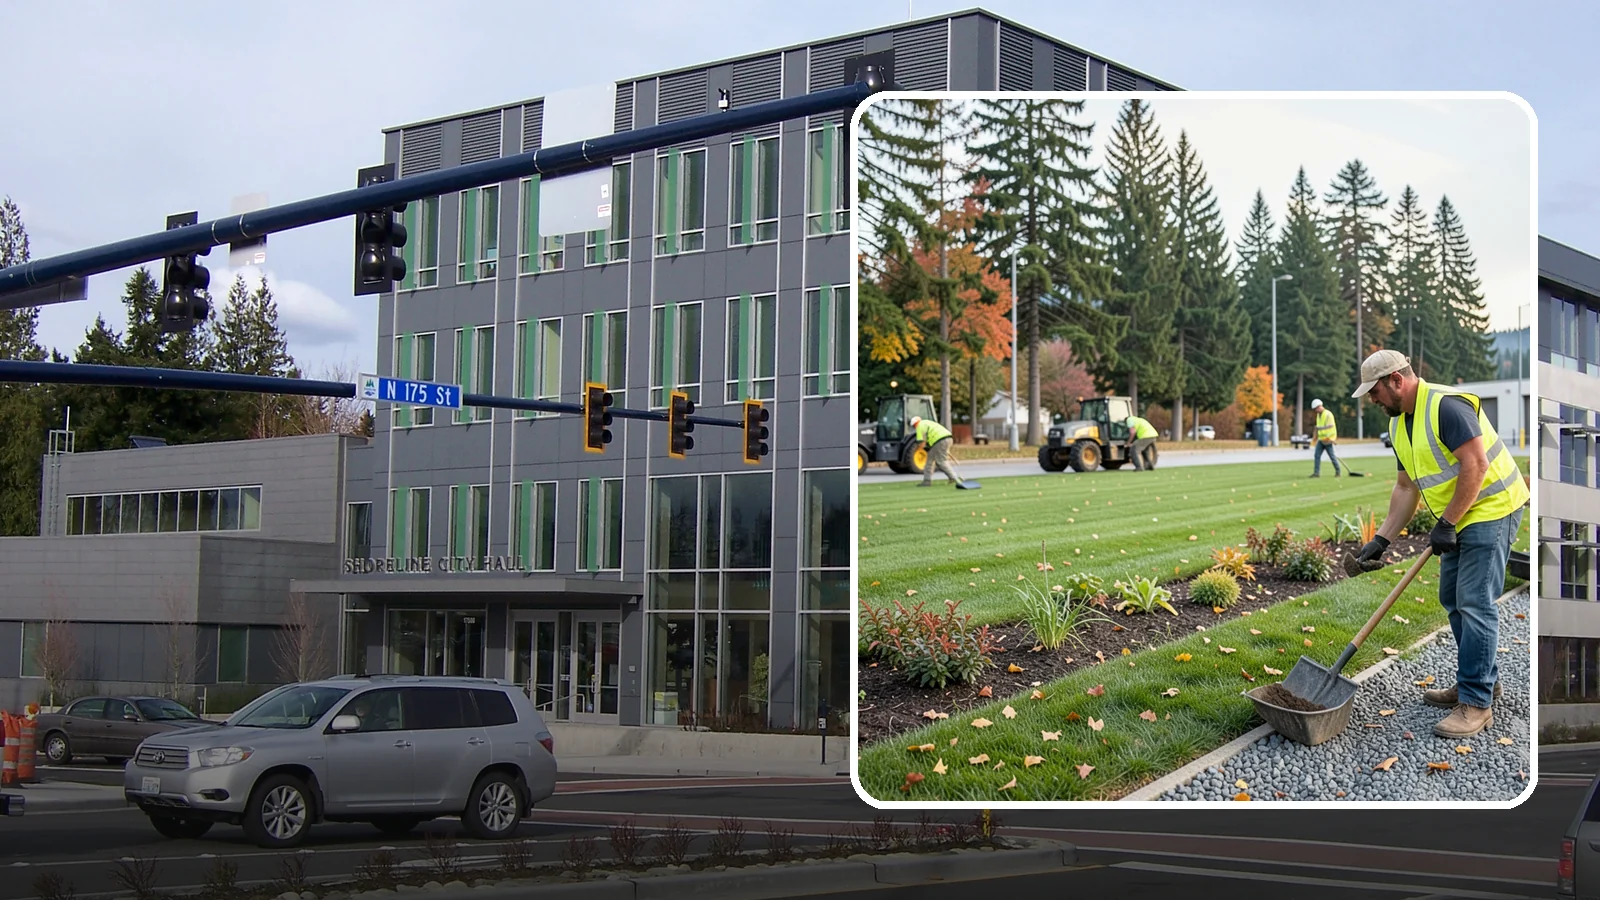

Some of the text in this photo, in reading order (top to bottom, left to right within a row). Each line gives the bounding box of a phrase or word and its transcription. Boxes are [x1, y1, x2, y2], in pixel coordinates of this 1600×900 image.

[387, 381, 451, 406] N 175 St
[344, 556, 526, 574] SHORELINE CITY HALL
